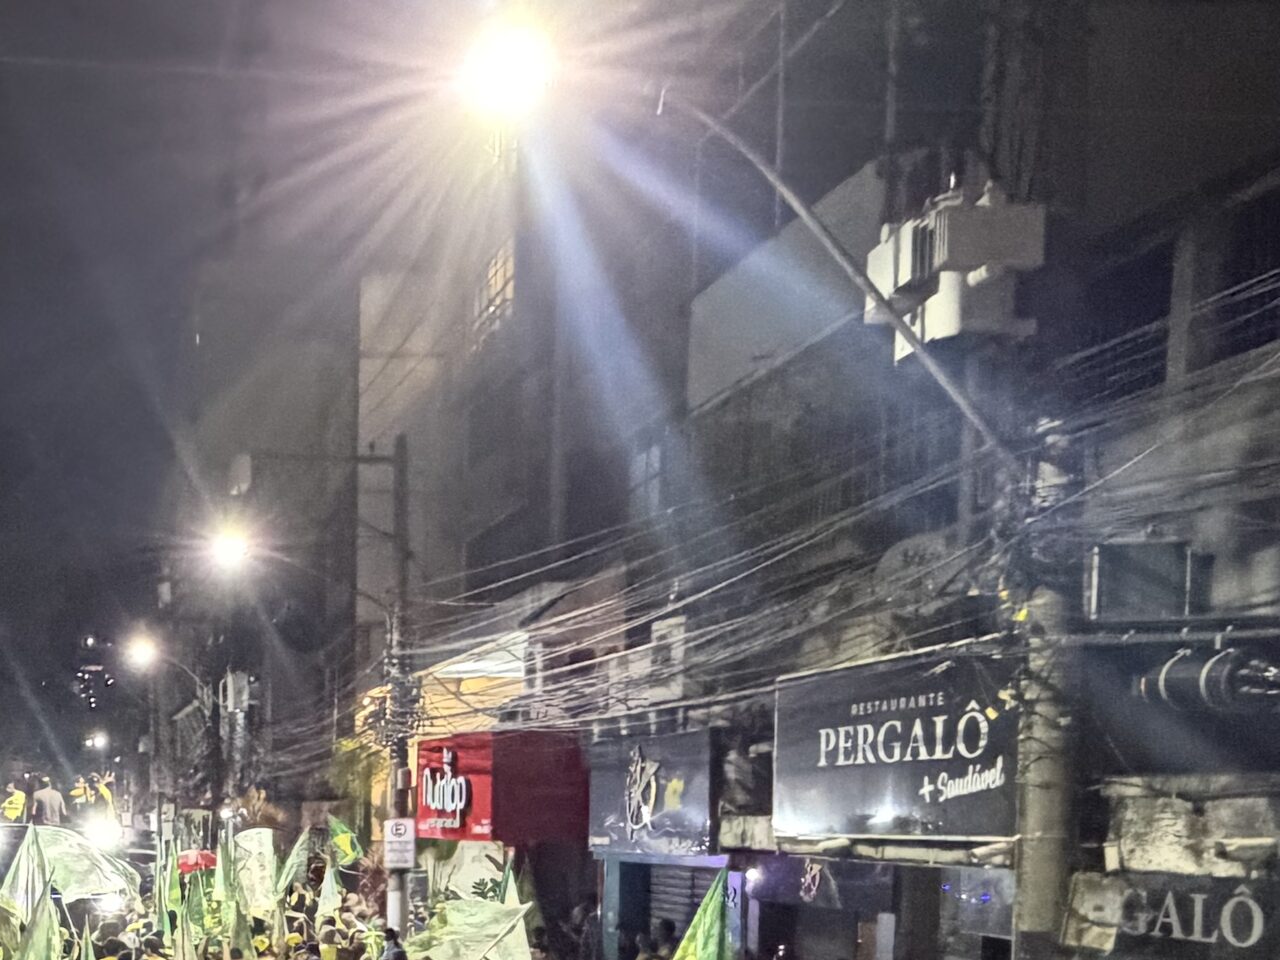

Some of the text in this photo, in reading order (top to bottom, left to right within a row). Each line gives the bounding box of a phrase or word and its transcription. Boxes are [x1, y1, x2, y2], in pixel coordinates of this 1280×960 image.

[851, 691, 945, 716] RESTAURANTE
[817, 699, 990, 767] PERGALÔ
[937, 755, 1006, 803] Saudável
[1120, 883, 1264, 948] GALÔ
